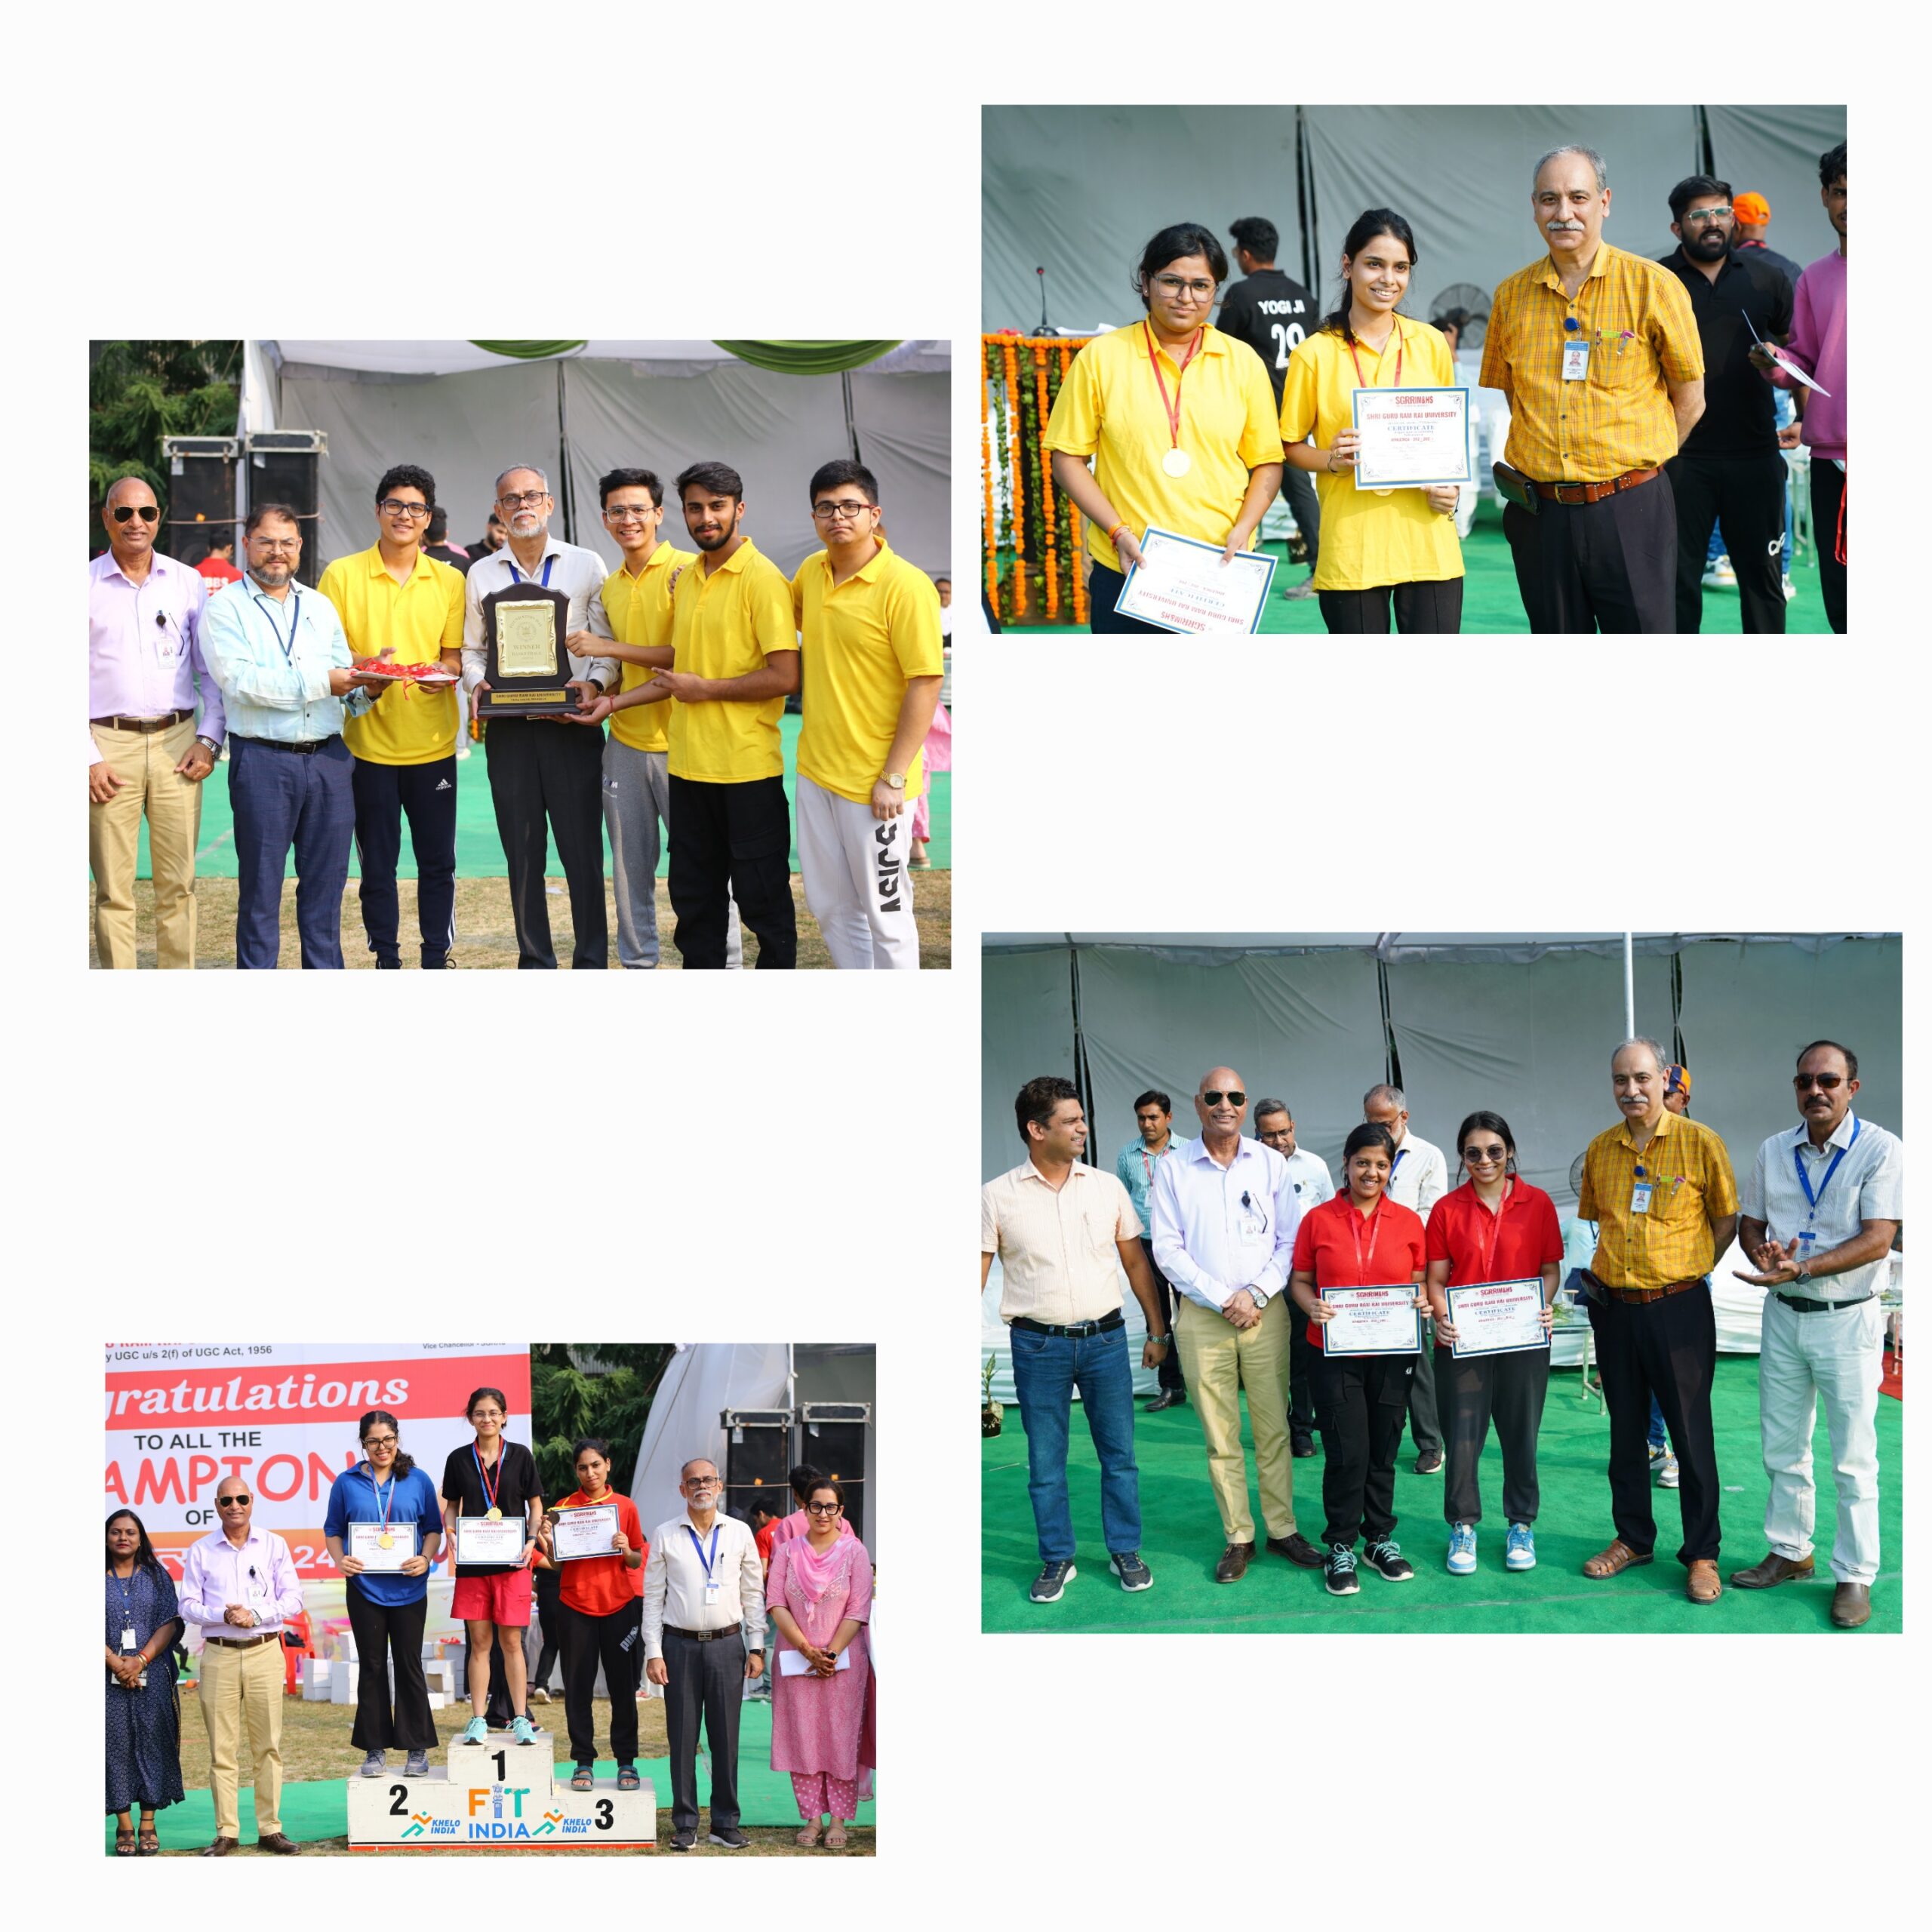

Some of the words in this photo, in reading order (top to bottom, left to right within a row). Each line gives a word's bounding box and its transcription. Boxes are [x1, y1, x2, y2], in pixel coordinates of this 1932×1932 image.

[1257, 300, 1291, 315] YOGI
[1292, 299, 1306, 314] JI
[1395, 395, 1434, 405] SGRRIM&HS
[202, 577, 229, 587] BBS
[1161, 611, 1206, 632] SGRRIM&HS
[115, 1352, 139, 1360] UGC
[143, 1351, 158, 1360] u/s
[162, 1349, 179, 1360] 2(f)
[182, 1349, 193, 1358] of
[195, 1348, 220, 1357] UGC
[223, 1347, 244, 1356] Act,
[248, 1346, 272, 1355] 1956
[134, 1435, 164, 1451] TO
[170, 1433, 211, 1449] ALL
[218, 1432, 262, 1447] THE
[185, 1510, 214, 1525] OF
[491, 1750, 506, 1782] 1
[389, 1784, 408, 1816] 2
[595, 1798, 614, 1830] 3
[468, 1823, 531, 1838] INDIA
